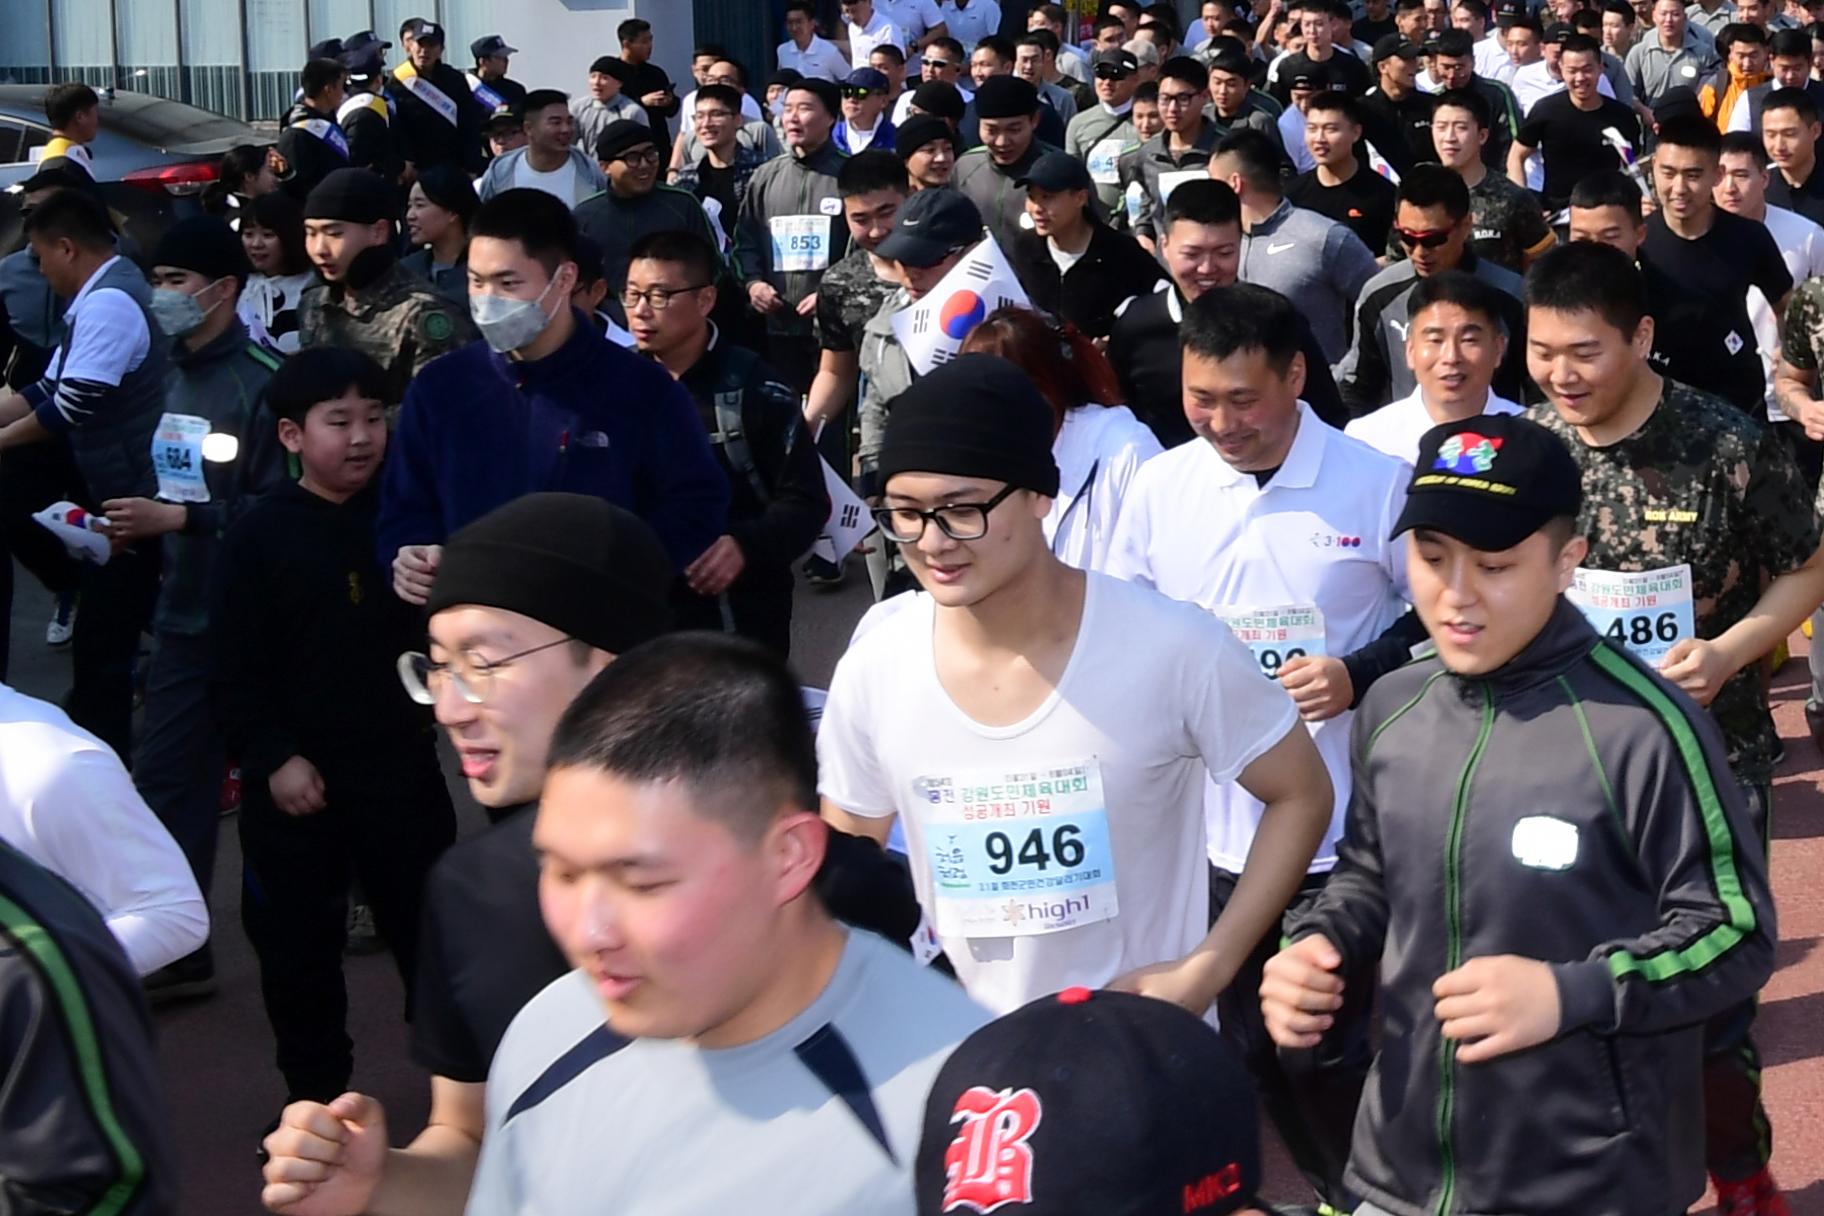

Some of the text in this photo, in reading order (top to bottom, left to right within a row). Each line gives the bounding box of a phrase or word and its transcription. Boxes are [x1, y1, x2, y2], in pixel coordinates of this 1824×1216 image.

[791, 236, 821, 250] 853
[1668, 510, 1698, 522] ARMY
[1590, 579, 1683, 596] 강원도민체육대회
[1635, 595, 1657, 607] 기원
[1606, 612, 1678, 645] 486
[961, 775, 1088, 804] 강원도민체육대회
[964, 798, 1051, 820] 성공개최 기원
[985, 824, 1086, 875] 946
[1028, 894, 1090, 922] high1
